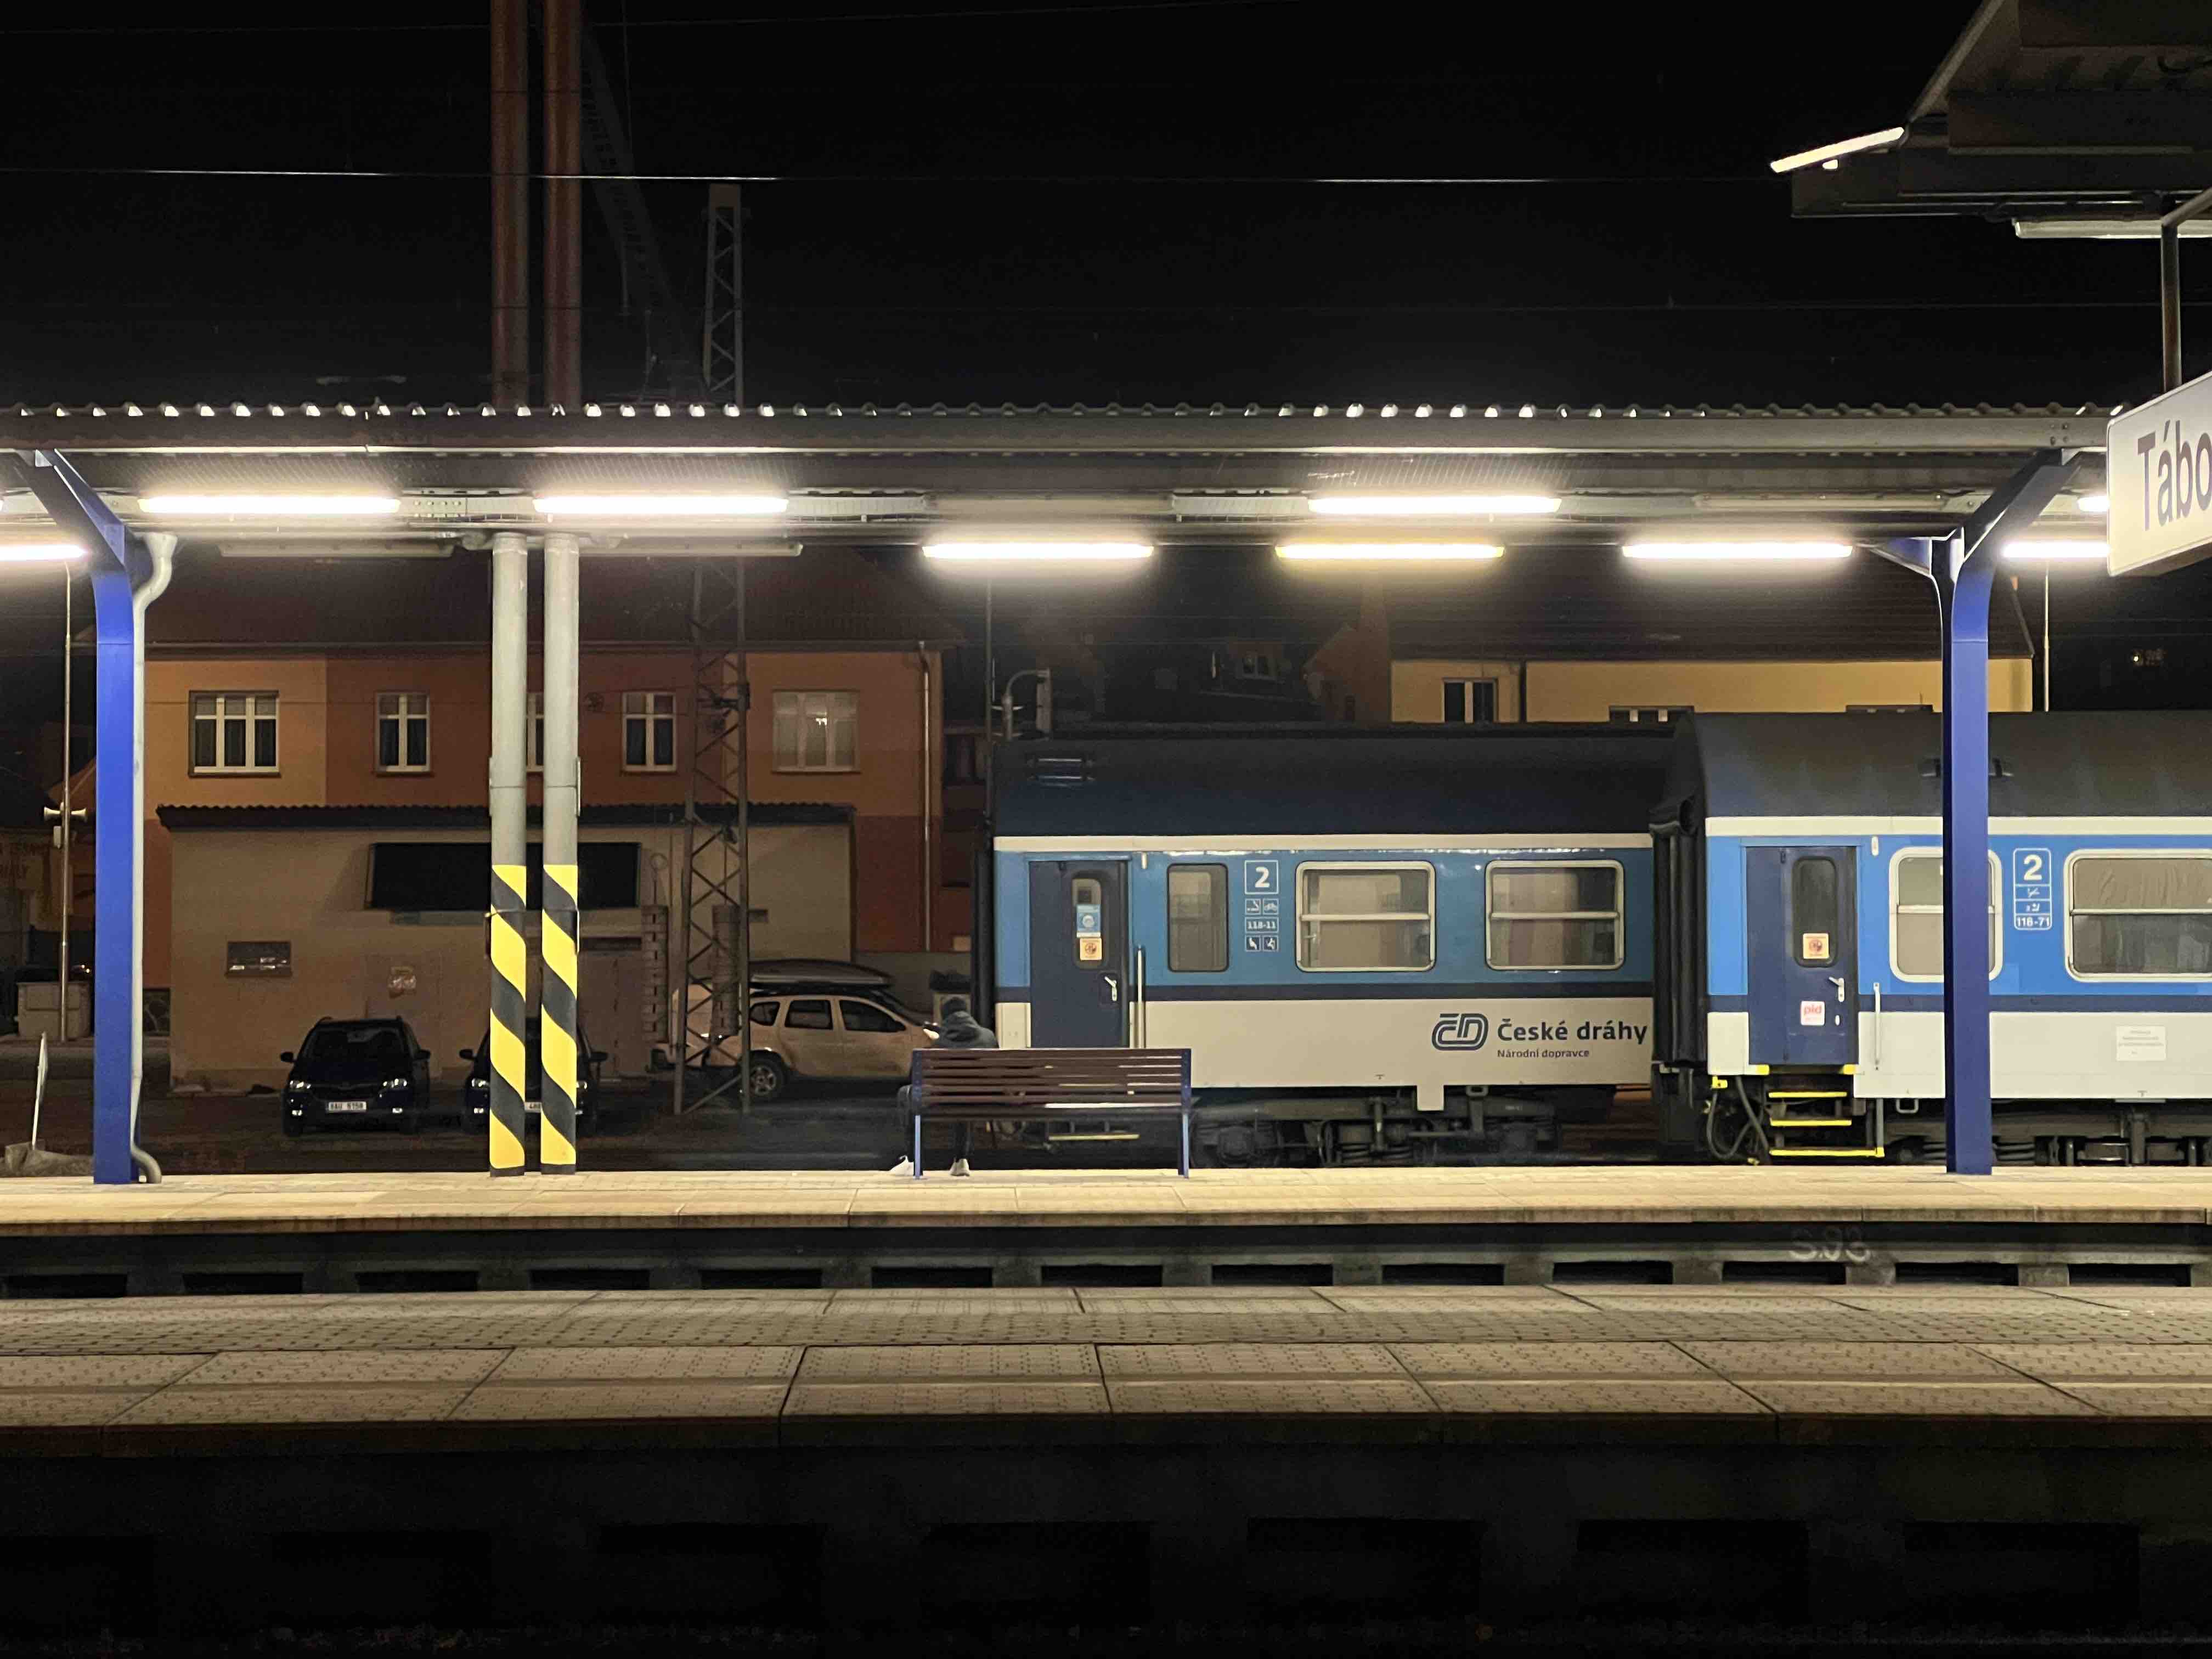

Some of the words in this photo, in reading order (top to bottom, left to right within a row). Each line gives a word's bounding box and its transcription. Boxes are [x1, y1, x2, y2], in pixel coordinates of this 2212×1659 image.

[1255, 867, 1270, 888] 2
[2023, 854, 2042, 881] 2
[1497, 1018, 1568, 1041] České
[1577, 1019, 1647, 1045] dráhy
[1497, 1048, 1539, 1058] Národní
[1542, 1048, 1589, 1059] dopravce
